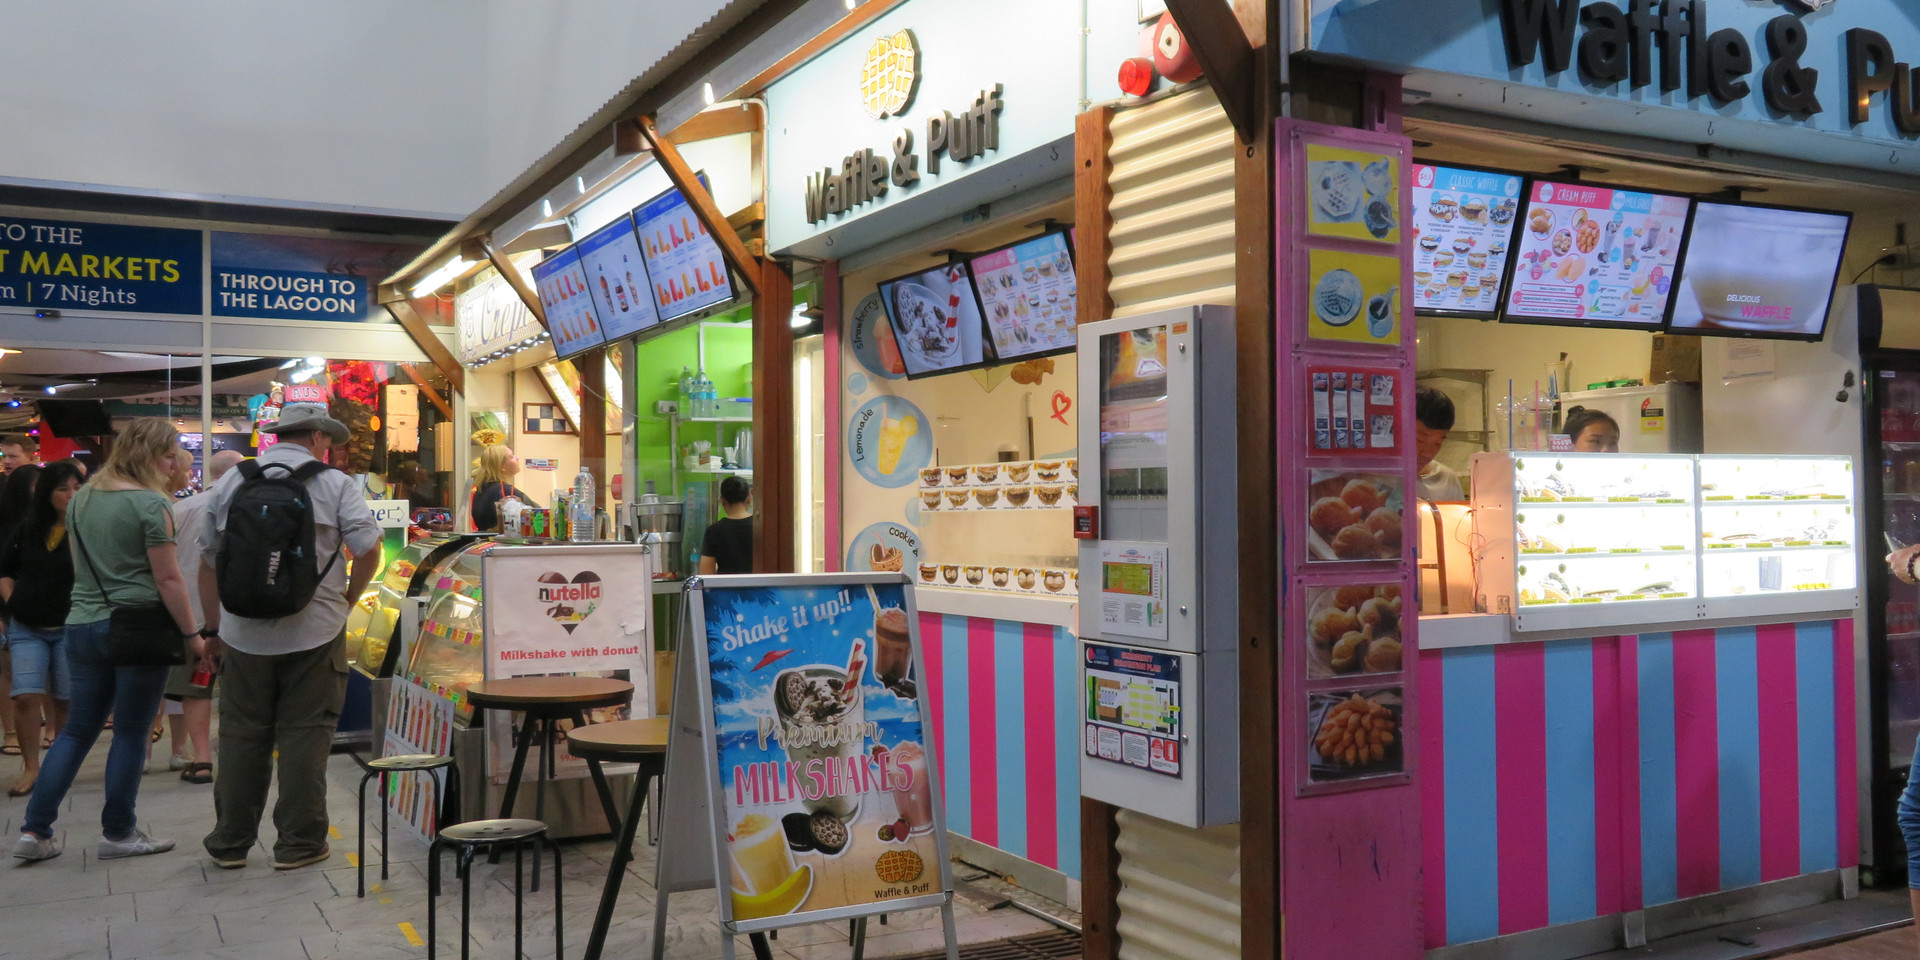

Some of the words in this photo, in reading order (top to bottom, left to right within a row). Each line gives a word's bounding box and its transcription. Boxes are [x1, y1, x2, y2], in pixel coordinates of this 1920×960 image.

[1500, 0, 1753, 103] Waffle
[1763, 14, 1823, 120] &
[804, 148, 889, 225] Waffle
[892, 127, 921, 188] &
[926, 82, 1004, 175] Puff
[1450, 174, 1476, 189] CLASSIC
[1477, 177, 1499, 191] WAFFLE
[1557, 188, 1579, 202] CREAM
[1580, 191, 1597, 204] PUFF
[31, 225, 82, 245] THE
[20, 250, 181, 283] MARKETS
[42, 283, 56, 300] 7
[61, 284, 137, 306] Nights
[220, 273, 324, 294] THROUGH
[329, 279, 356, 295] TO
[220, 292, 258, 309] THE
[264, 295, 356, 313] LAGOON
[1726, 294, 1761, 304] DELICIOUS
[1741, 305, 1793, 320] WAFFLE
[293, 387, 320, 399] AUS
[856, 408, 874, 462] Lemonade
[266, 550, 281, 585] THULE
[539, 583, 601, 602] nutella
[722, 613, 789, 651] Shake
[792, 605, 809, 628] it
[813, 589, 852, 625] up!!
[500, 648, 567, 661] Milkshake
[570, 646, 598, 657] with
[602, 645, 639, 656] donut
[757, 716, 884, 751] Premium
[734, 751, 915, 806] MILKSHAKES
[874, 885, 902, 899] Waffle
[903, 885, 910, 895] &
[912, 882, 929, 894] Puff
